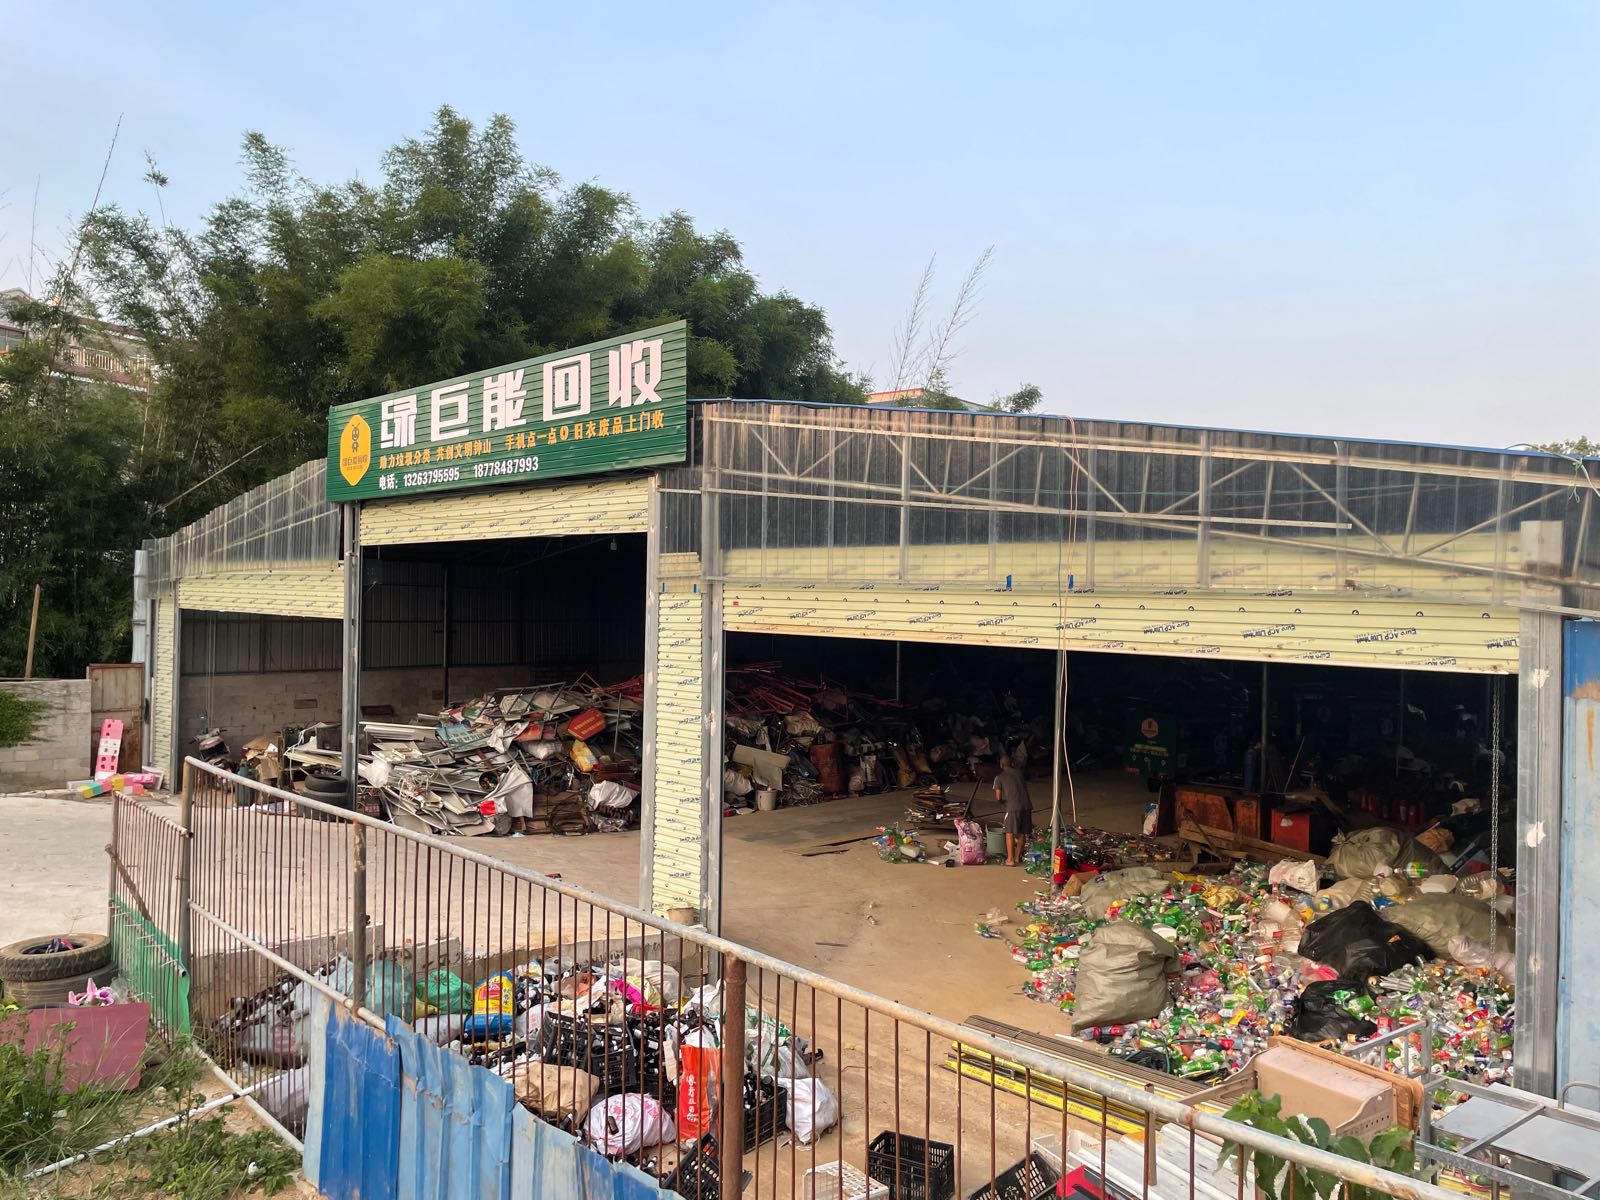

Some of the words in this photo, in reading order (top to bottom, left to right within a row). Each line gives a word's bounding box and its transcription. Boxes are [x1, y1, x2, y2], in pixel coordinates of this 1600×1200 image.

[380, 338, 664, 449] 绿巨能回收
[379, 448, 430, 470] 助力垃圾分类
[436, 438, 491, 462] 共创文明钟山
[504, 427, 557, 451] 手机点一点
[573, 409, 664, 440] 旧衣废品上门收
[403, 467, 460, 488] 13263795595
[473, 455, 539, 478] 18778487993
